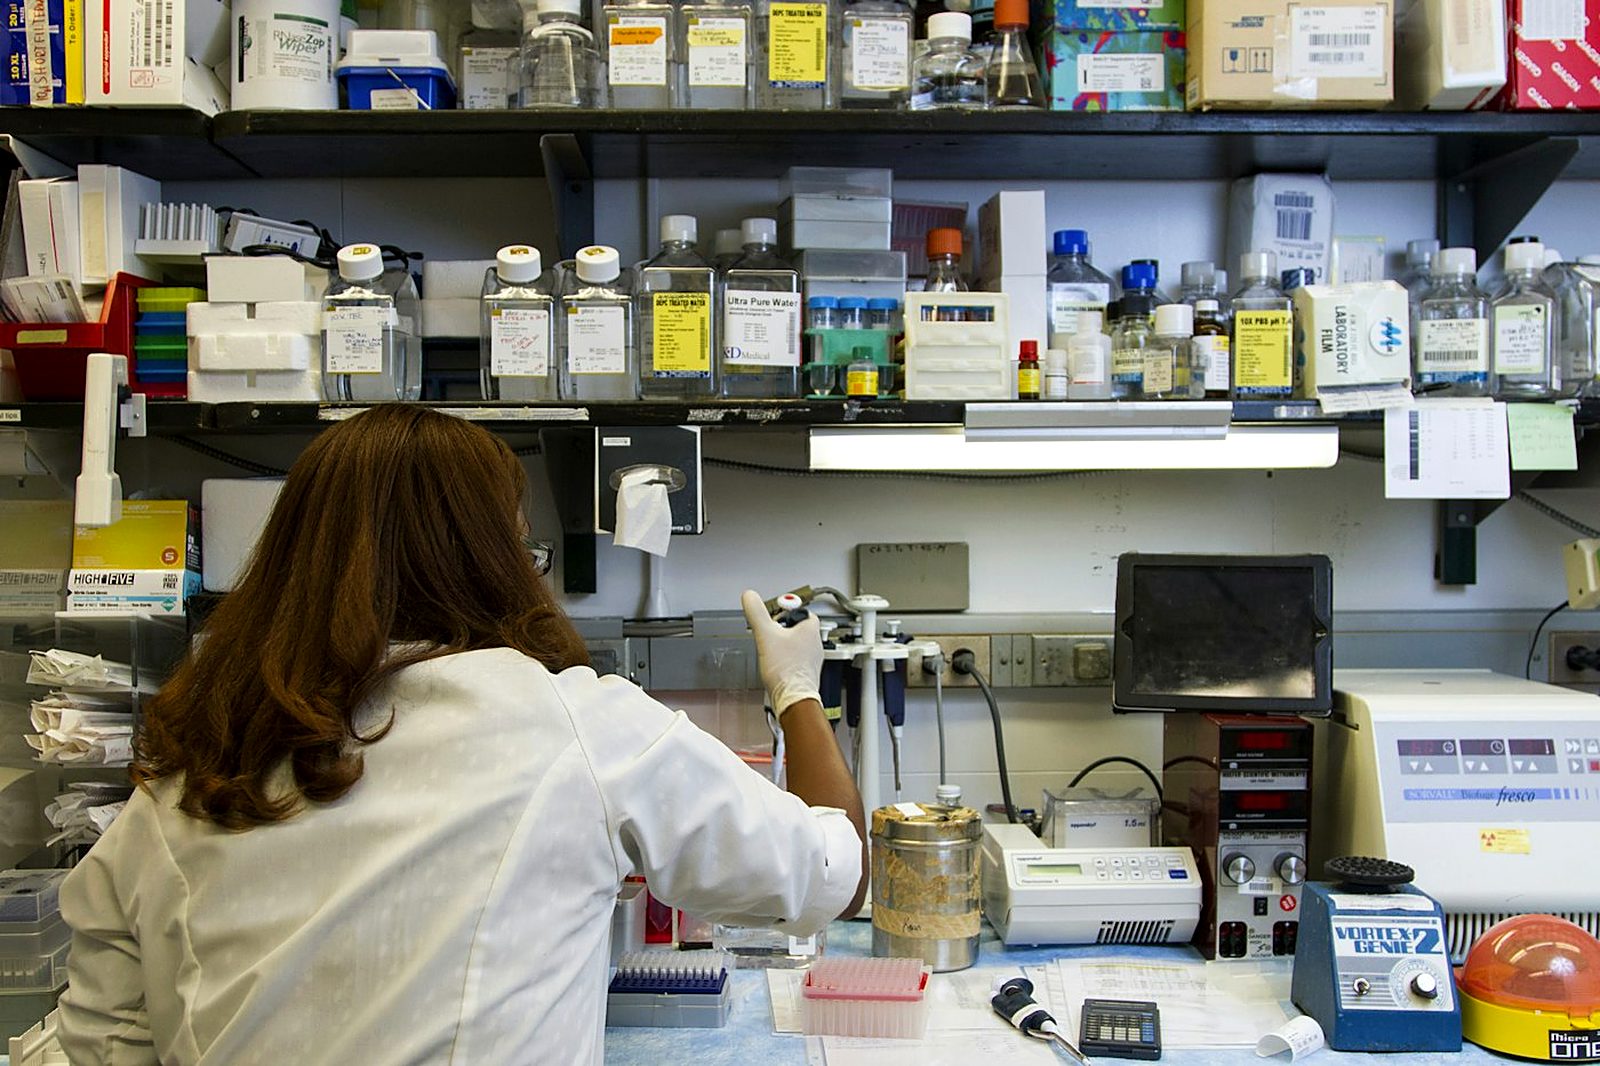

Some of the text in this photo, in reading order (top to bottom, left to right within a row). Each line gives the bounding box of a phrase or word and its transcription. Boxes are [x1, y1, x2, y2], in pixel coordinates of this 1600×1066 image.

[9, 14, 18, 27] 20
[69, 35, 76, 44] To
[279, 38, 317, 54] Wipes
[10, 52, 20, 79] 10 XL
[728, 297, 799, 308] Ultra Pure Water
[1270, 318, 1280, 327] pH
[1321, 328, 1334, 353] FILM
[1335, 305, 1349, 374] LABORATORY
[742, 351, 770, 360] Medical
[165, 552, 175, 562] S
[74, 573, 134, 585] HIGH FIVE
[1496, 786, 1536, 806] fresco
[1125, 819, 1138, 828] 1.5
[1354, 928, 1444, 955] GENIE 2
[1551, 1032, 1589, 1042] Micro
